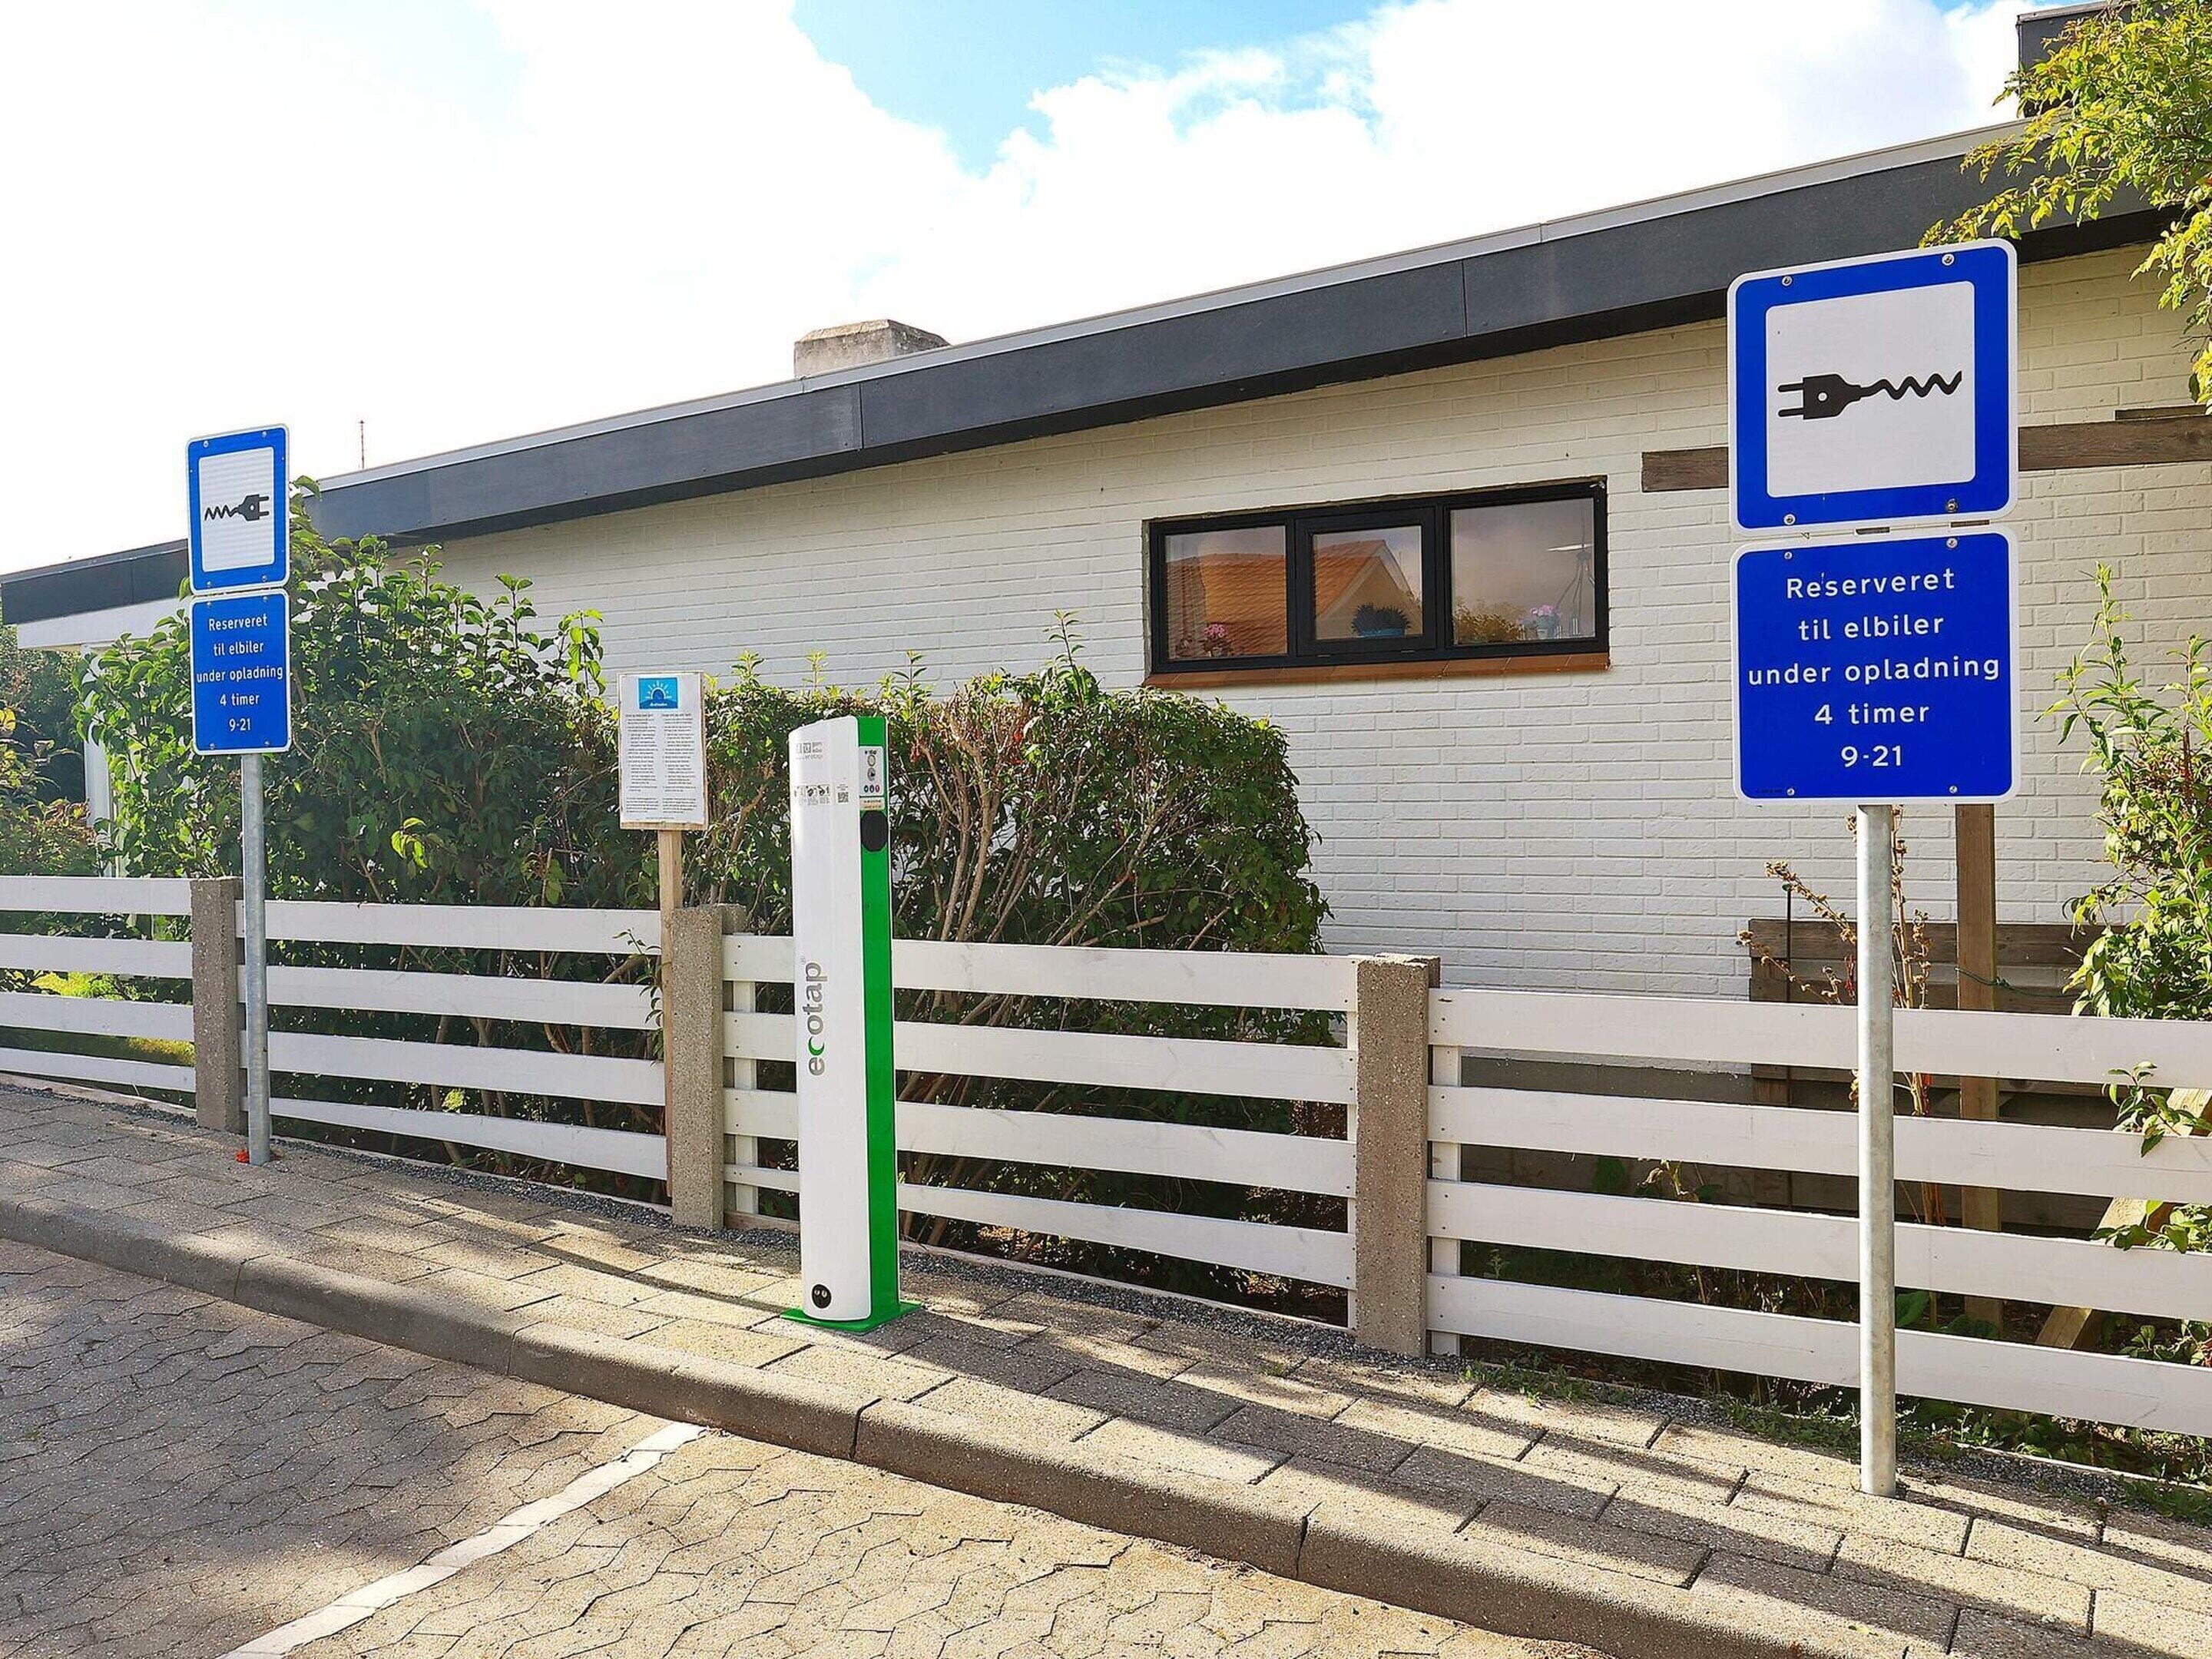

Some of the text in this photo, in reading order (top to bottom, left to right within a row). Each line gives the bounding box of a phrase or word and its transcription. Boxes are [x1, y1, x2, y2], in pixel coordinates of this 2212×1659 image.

[1787, 568, 1955, 599] Reserveret
[209, 613, 267, 631] Reserveret
[1798, 614, 1944, 641] til elbiler
[214, 641, 264, 656] til elbiler
[197, 666, 283, 683] under opladning
[1749, 655, 1999, 685] under opladning
[220, 693, 260, 706] 4 timer
[1814, 703, 1929, 724] 4 timer
[229, 718, 251, 732] 9-21
[1841, 745, 1902, 767] 9-21
[802, 962, 828, 1076] ecotap
